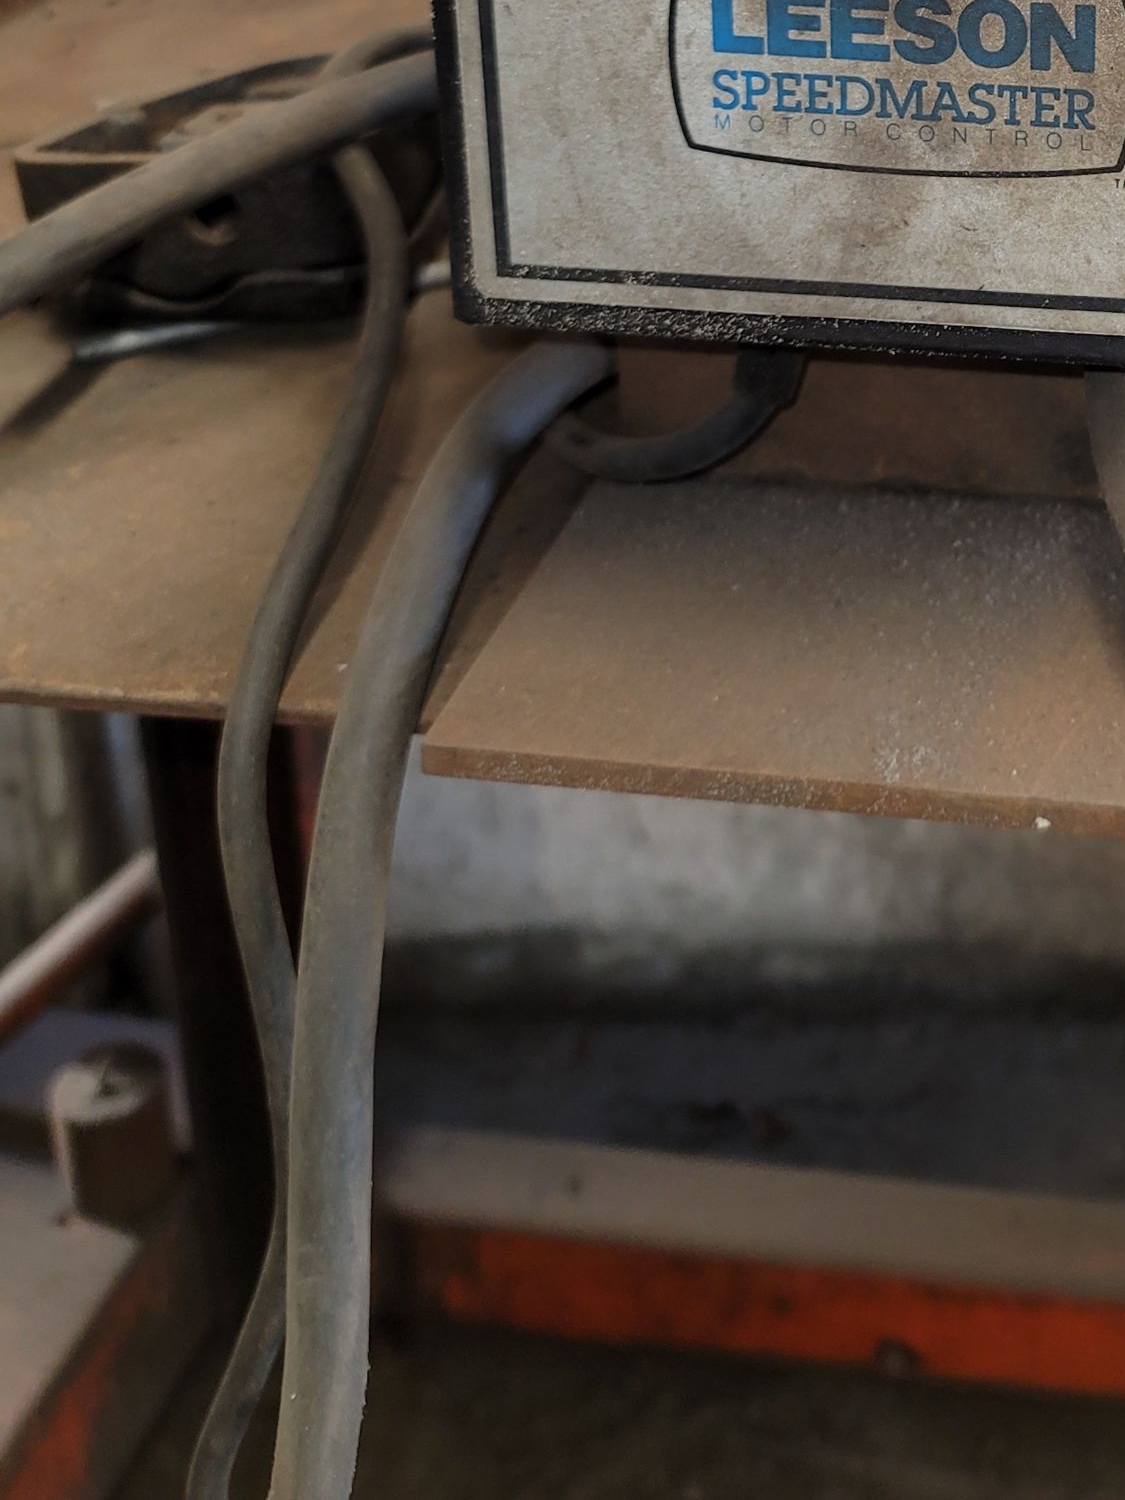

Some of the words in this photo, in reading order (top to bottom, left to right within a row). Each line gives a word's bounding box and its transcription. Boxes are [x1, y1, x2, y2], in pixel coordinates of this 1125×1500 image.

[712, 69, 1096, 131] SPEEDMASTER
[714, 114, 858, 137] MOTOR
[887, 123, 1091, 152] CONTROL
